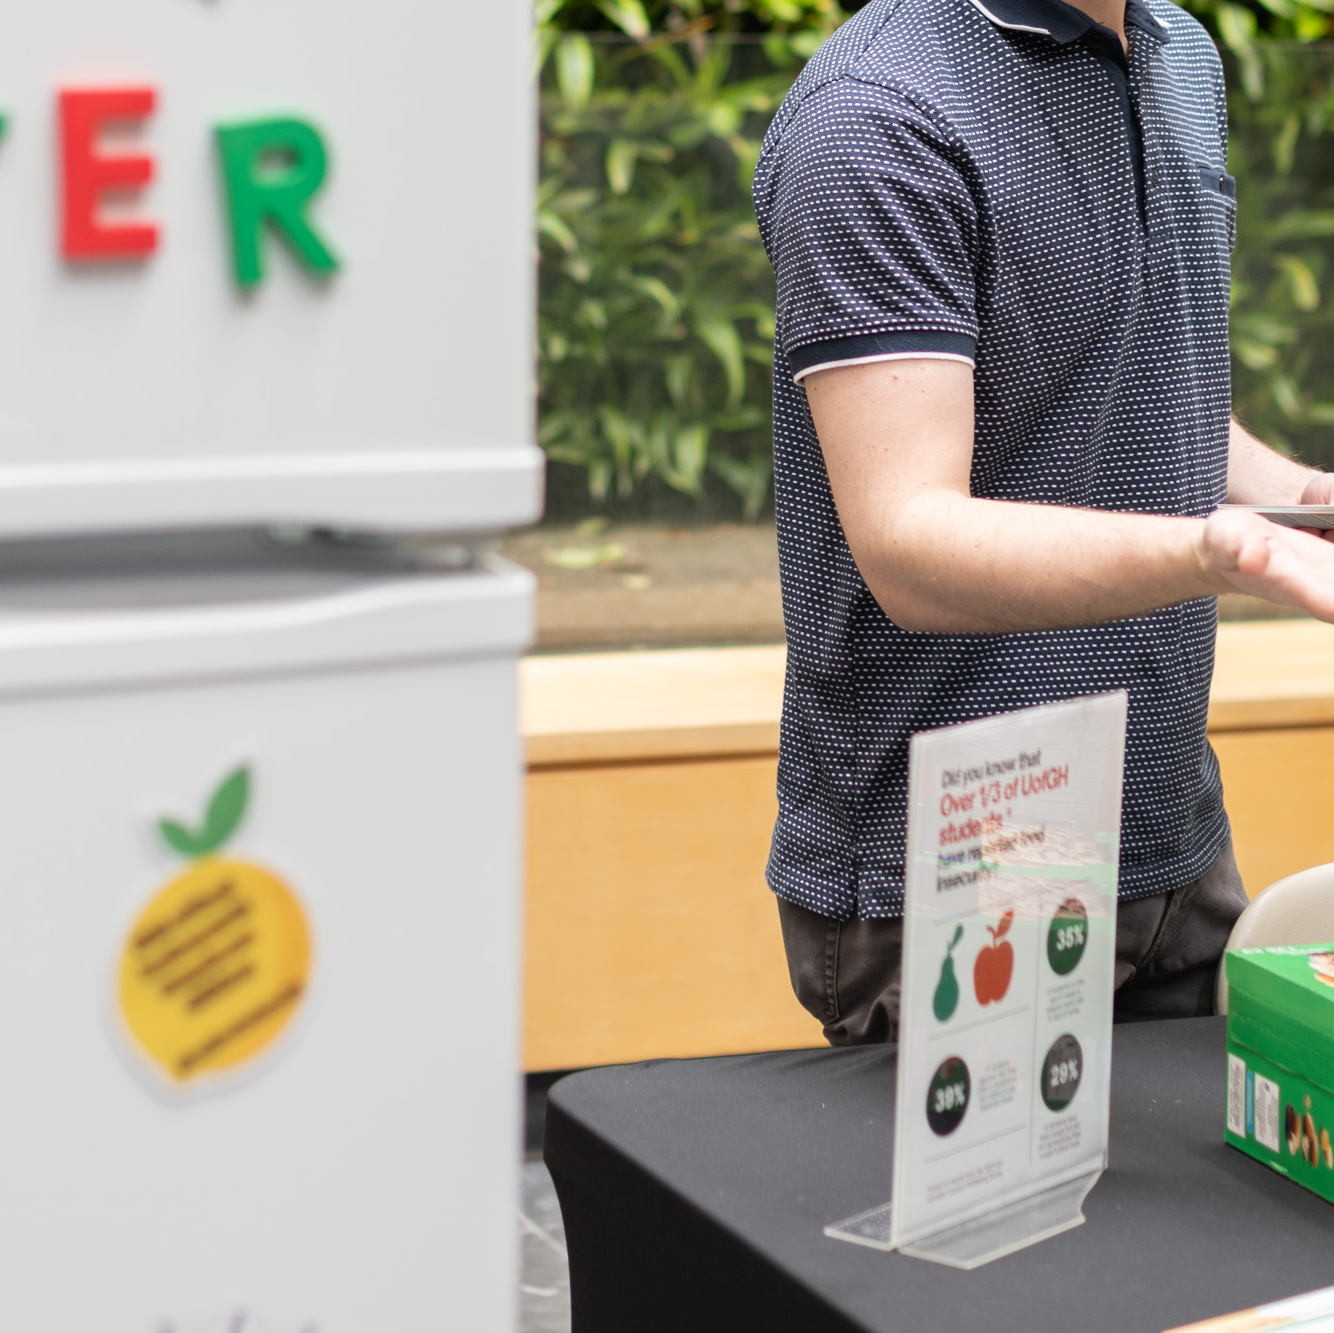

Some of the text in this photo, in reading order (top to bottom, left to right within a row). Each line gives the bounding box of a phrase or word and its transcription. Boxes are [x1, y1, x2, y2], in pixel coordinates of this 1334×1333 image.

[963, 768, 983, 786] you
[986, 757, 1016, 777] know
[1019, 748, 1041, 770] that
[940, 764, 1069, 817] Over 1/3 of UofGH
[1056, 922, 1085, 951] 35%
[1050, 1059, 1079, 1087] 29%
